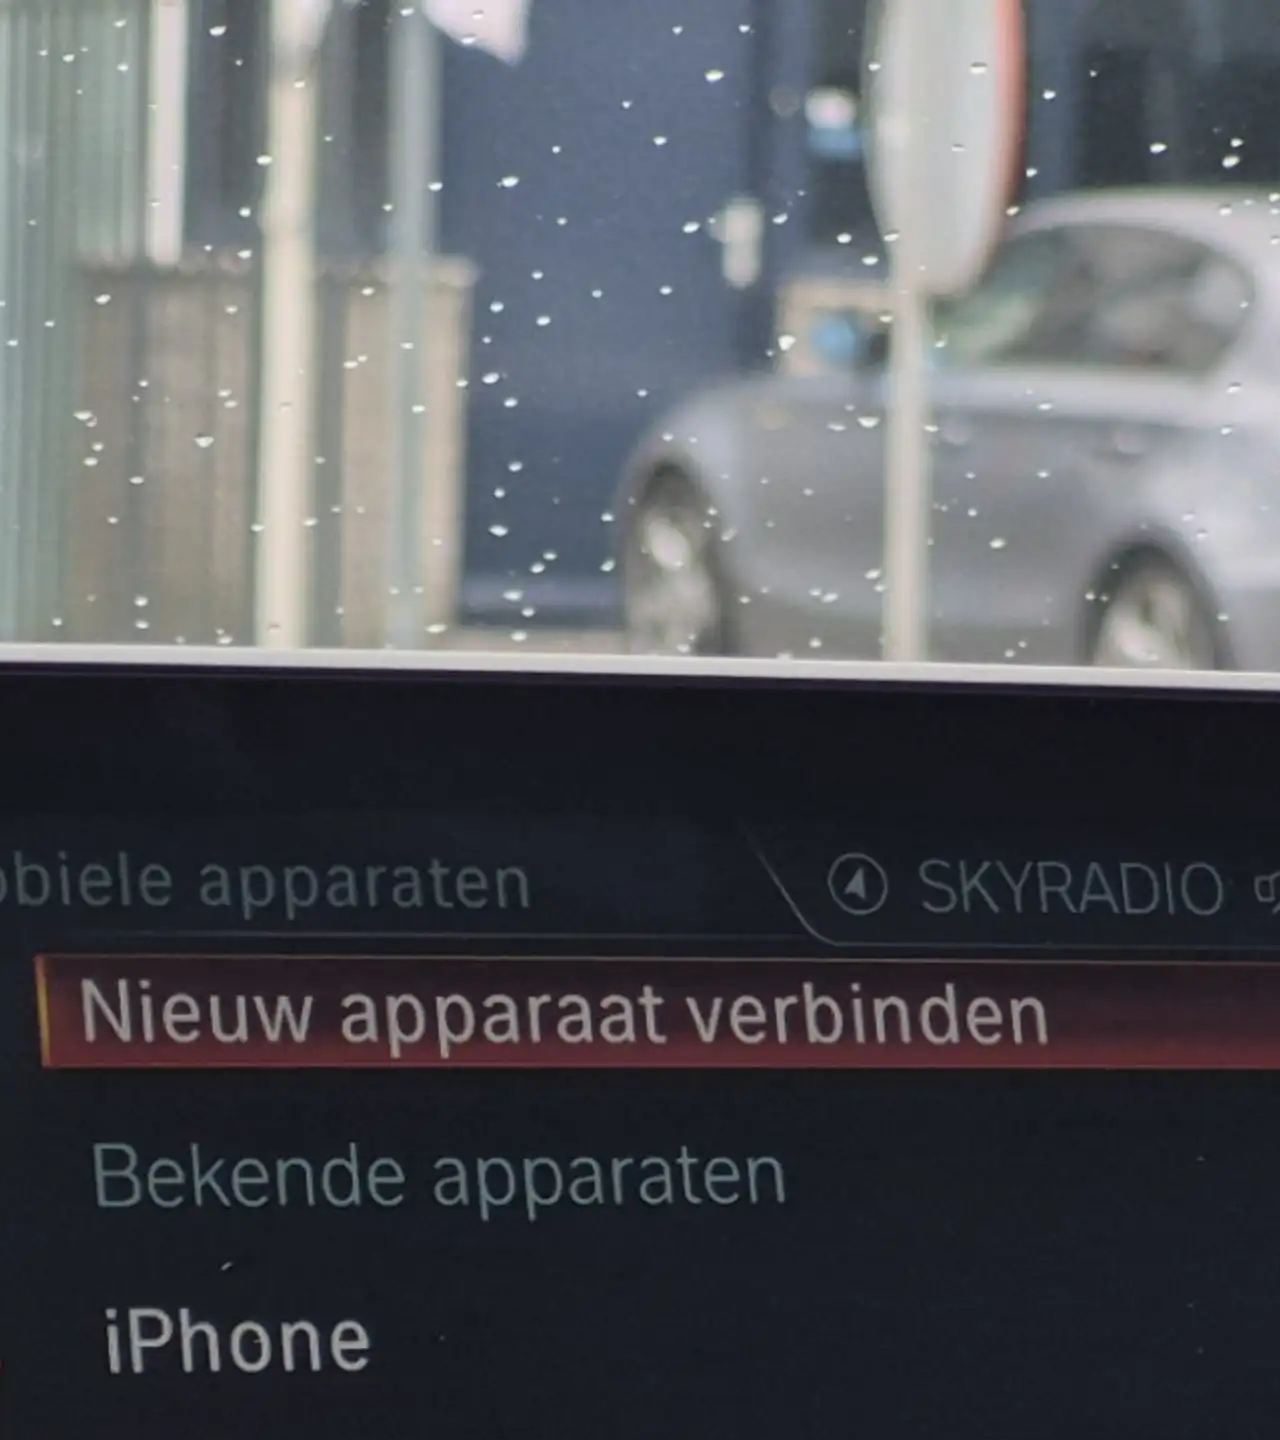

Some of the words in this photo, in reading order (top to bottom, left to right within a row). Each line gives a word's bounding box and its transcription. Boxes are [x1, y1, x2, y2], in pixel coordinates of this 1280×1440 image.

[199, 856, 531, 920] apparaten
[918, 857, 1226, 916] SKYRADIO
[81, 978, 314, 1043] Nieuw
[340, 984, 667, 1059] apparaat
[685, 981, 1049, 1046] verbinden
[92, 1142, 406, 1209] Bekende
[433, 1144, 786, 1222] apparaten
[104, 1307, 371, 1375] iPhone
